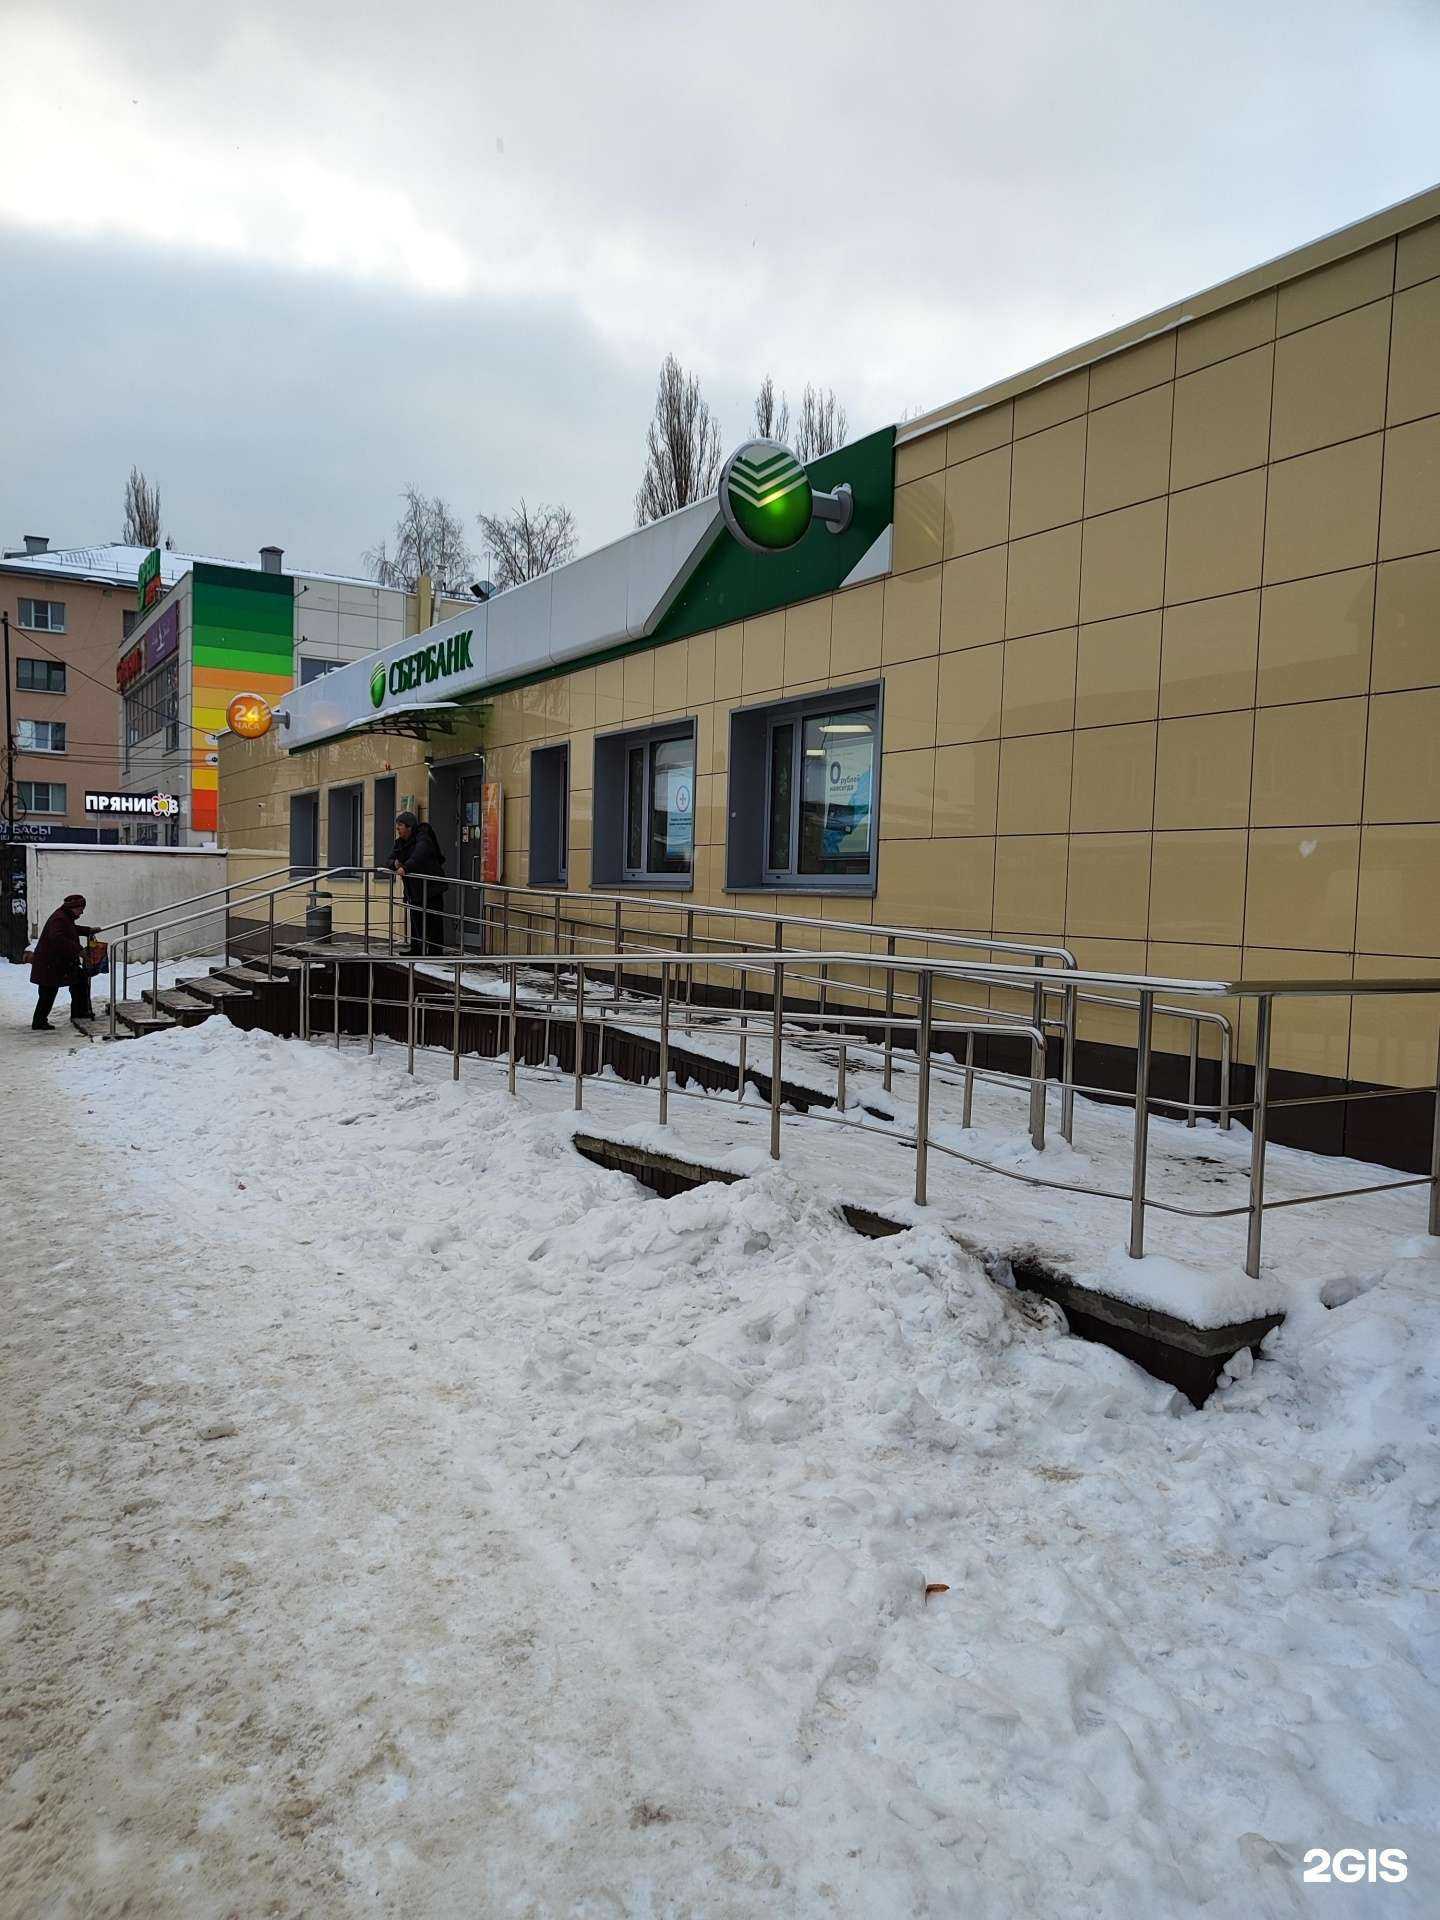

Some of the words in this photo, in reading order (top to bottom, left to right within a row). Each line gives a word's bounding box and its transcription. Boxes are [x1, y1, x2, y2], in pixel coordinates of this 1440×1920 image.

[388, 629, 474, 695] СБЕРБАНК
[234, 704, 259, 721] 24
[85, 793, 179, 817] ПРЯНИКОВ
